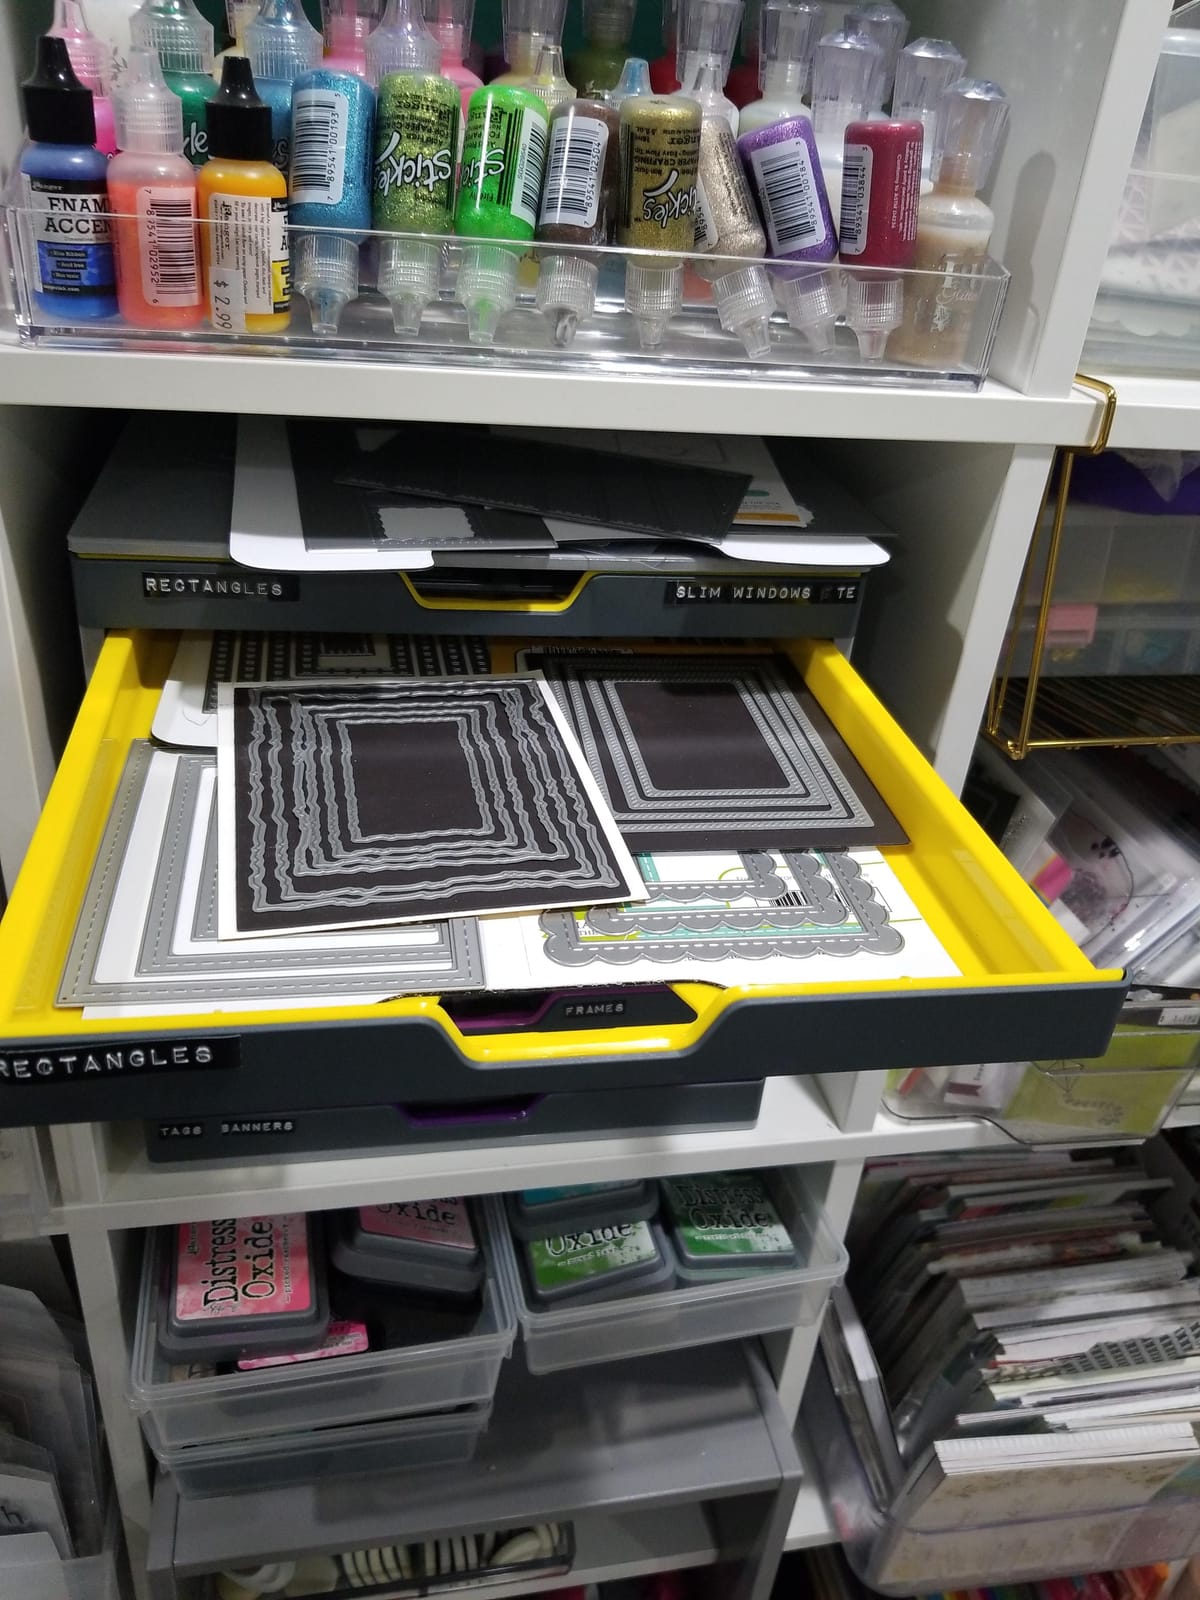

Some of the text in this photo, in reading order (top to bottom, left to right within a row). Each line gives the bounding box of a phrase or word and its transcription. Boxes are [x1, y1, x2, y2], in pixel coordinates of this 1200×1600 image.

[328, 112, 339, 146] 00193
[326, 150, 337, 183] 89541
[589, 141, 602, 173] 02504
[584, 176, 598, 208] 89541
[799, 160, 811, 192] 00184
[856, 166, 866, 199] 03844
[805, 195, 818, 226] 89541
[855, 203, 864, 235] 89541
[149, 249, 160, 284] 02952
[213, 279, 233, 330] $ 2.99
[145, 577, 283, 596] RECTANGLES
[676, 585, 856, 600] SLIM WINDOWS TE
[565, 1003, 624, 1016] FRAMES
[0, 1046, 213, 1079] RECTANGLES
[161, 1120, 294, 1137] TAGS BANNERS
[676, 1183, 764, 1207] Distress
[690, 1207, 769, 1231] Oxide
[203, 1216, 239, 1309] Distress
[240, 1219, 275, 1299] Oxide
